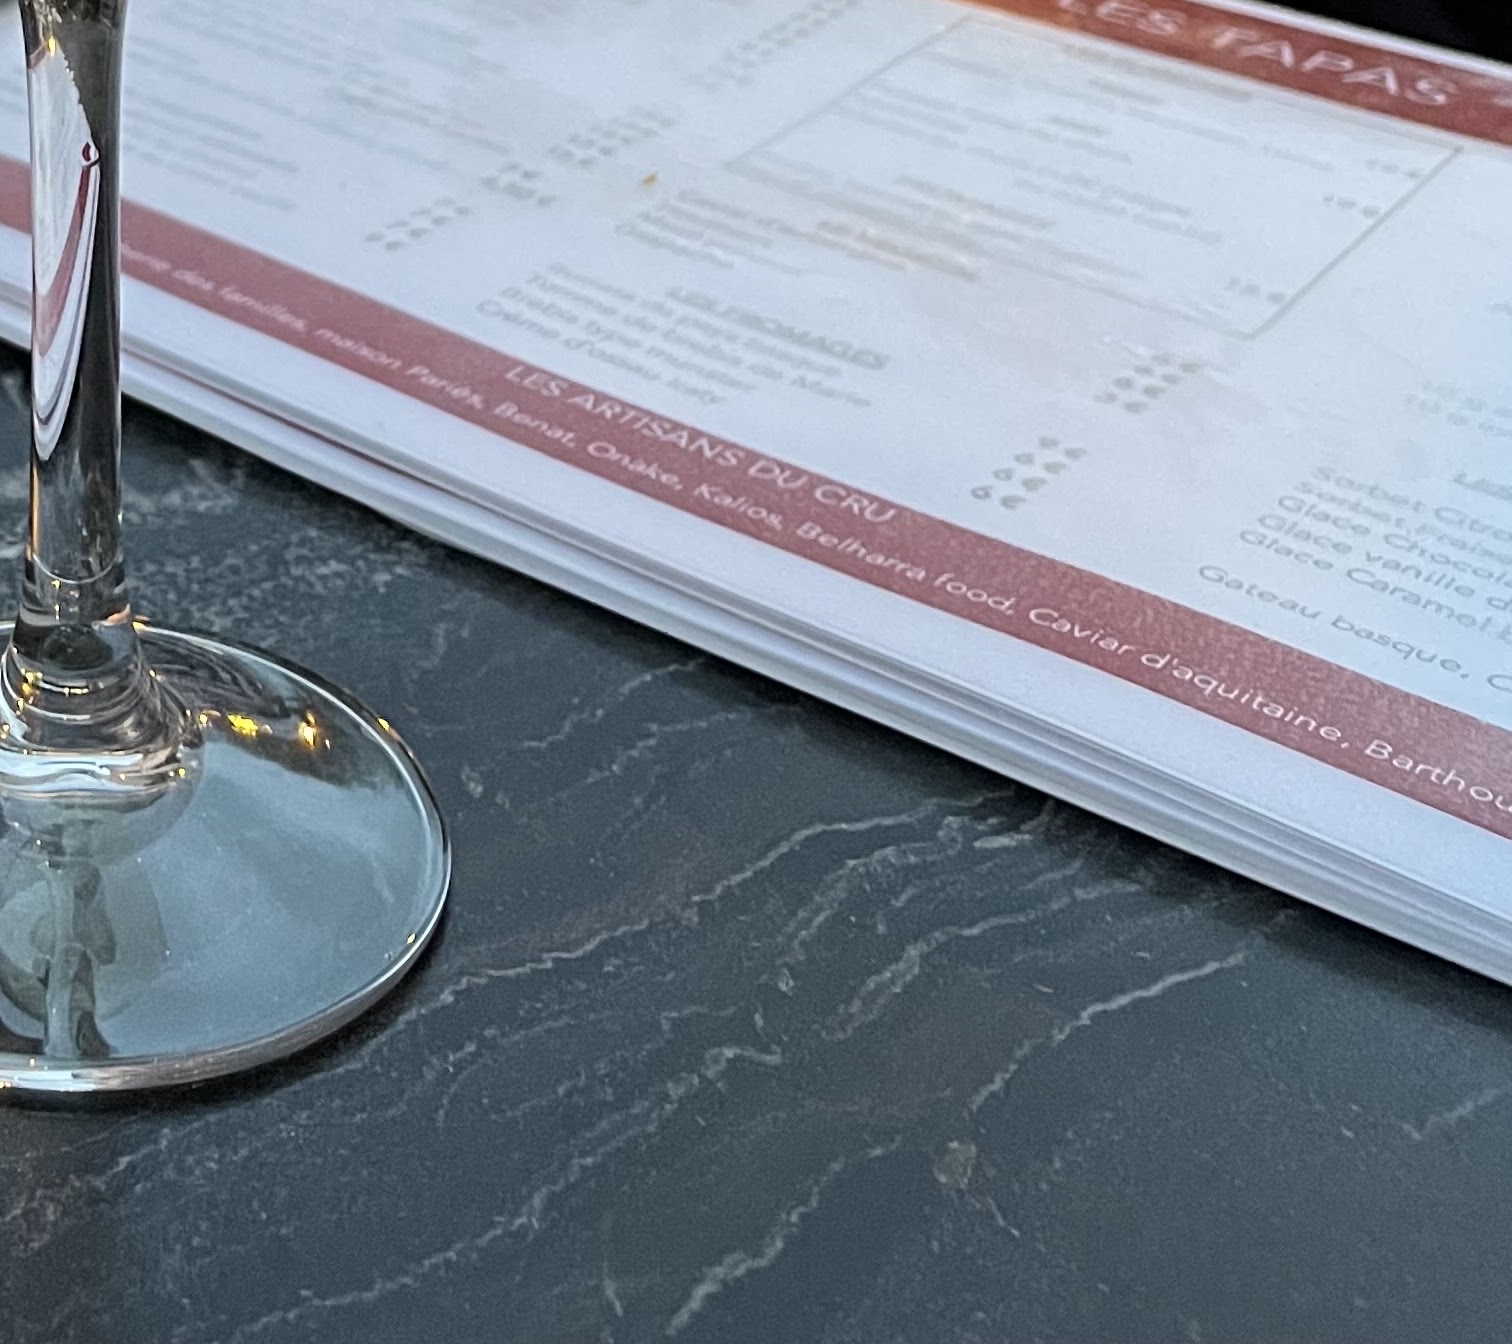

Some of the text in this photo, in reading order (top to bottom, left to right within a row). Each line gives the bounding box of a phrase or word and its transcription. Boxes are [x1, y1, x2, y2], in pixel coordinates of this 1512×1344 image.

[1211, 26, 1458, 106] TAPAS
[504, 366, 895, 524] LES ARTISANS DU CRU
[314, 328, 403, 370] maison
[588, 441, 684, 491] Onake,
[797, 521, 927, 584] Belharra
[933, 572, 1016, 618] food,
[1029, 608, 1132, 657] Caviar
[1140, 649, 1350, 750] d'aquitaine,
[1257, 514, 1353, 554] Glace
[1365, 550, 1476, 598] vanille
[1278, 495, 1371, 535] Glace
[1199, 564, 1322, 619] Gateau
[1331, 615, 1471, 680] basque,
[1240, 529, 1493, 633] Glace Caramel
